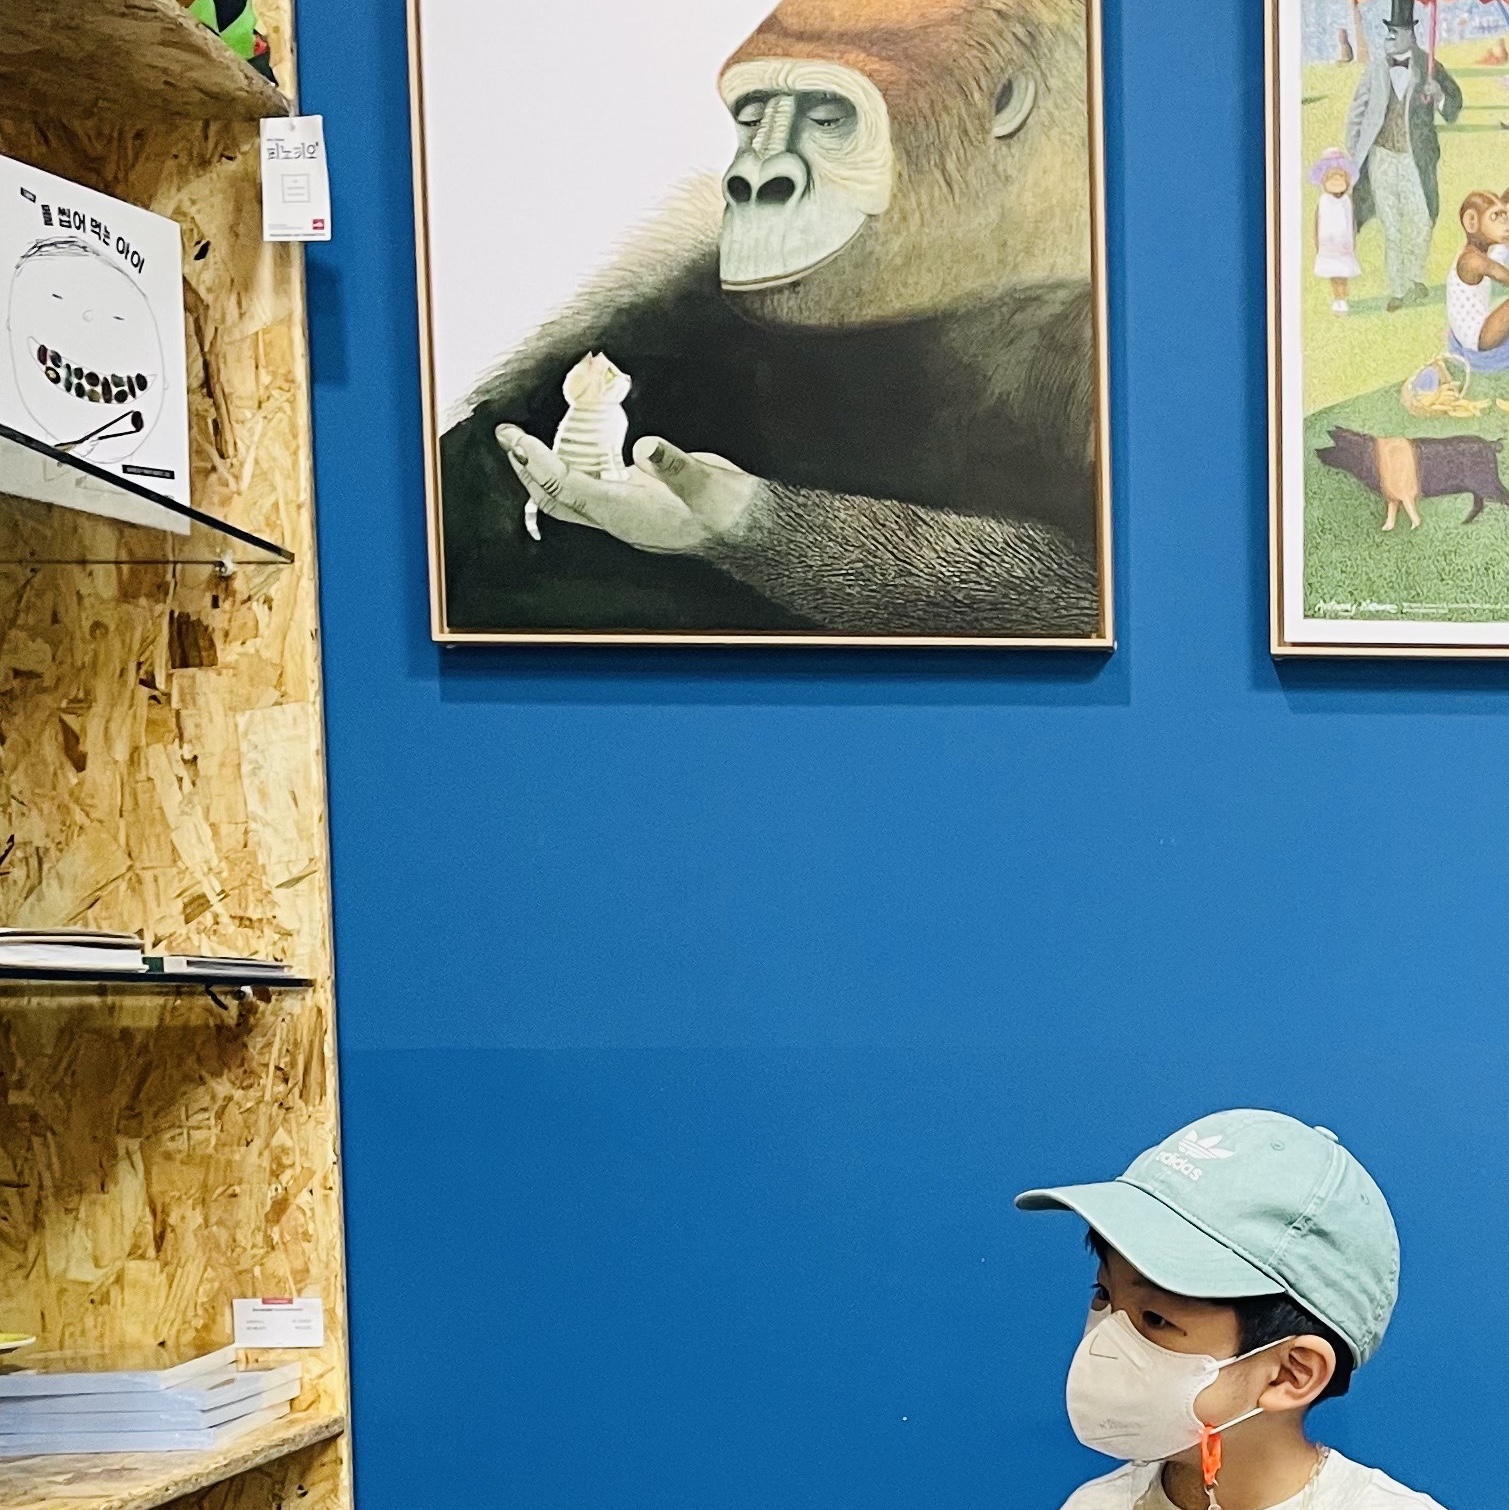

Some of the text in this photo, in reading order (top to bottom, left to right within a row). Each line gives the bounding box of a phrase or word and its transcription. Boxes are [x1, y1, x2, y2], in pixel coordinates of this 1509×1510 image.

[90, 217, 111, 246] 먹는
[116, 236, 145, 274] 아이
[1155, 1151, 1203, 1181] adidas
